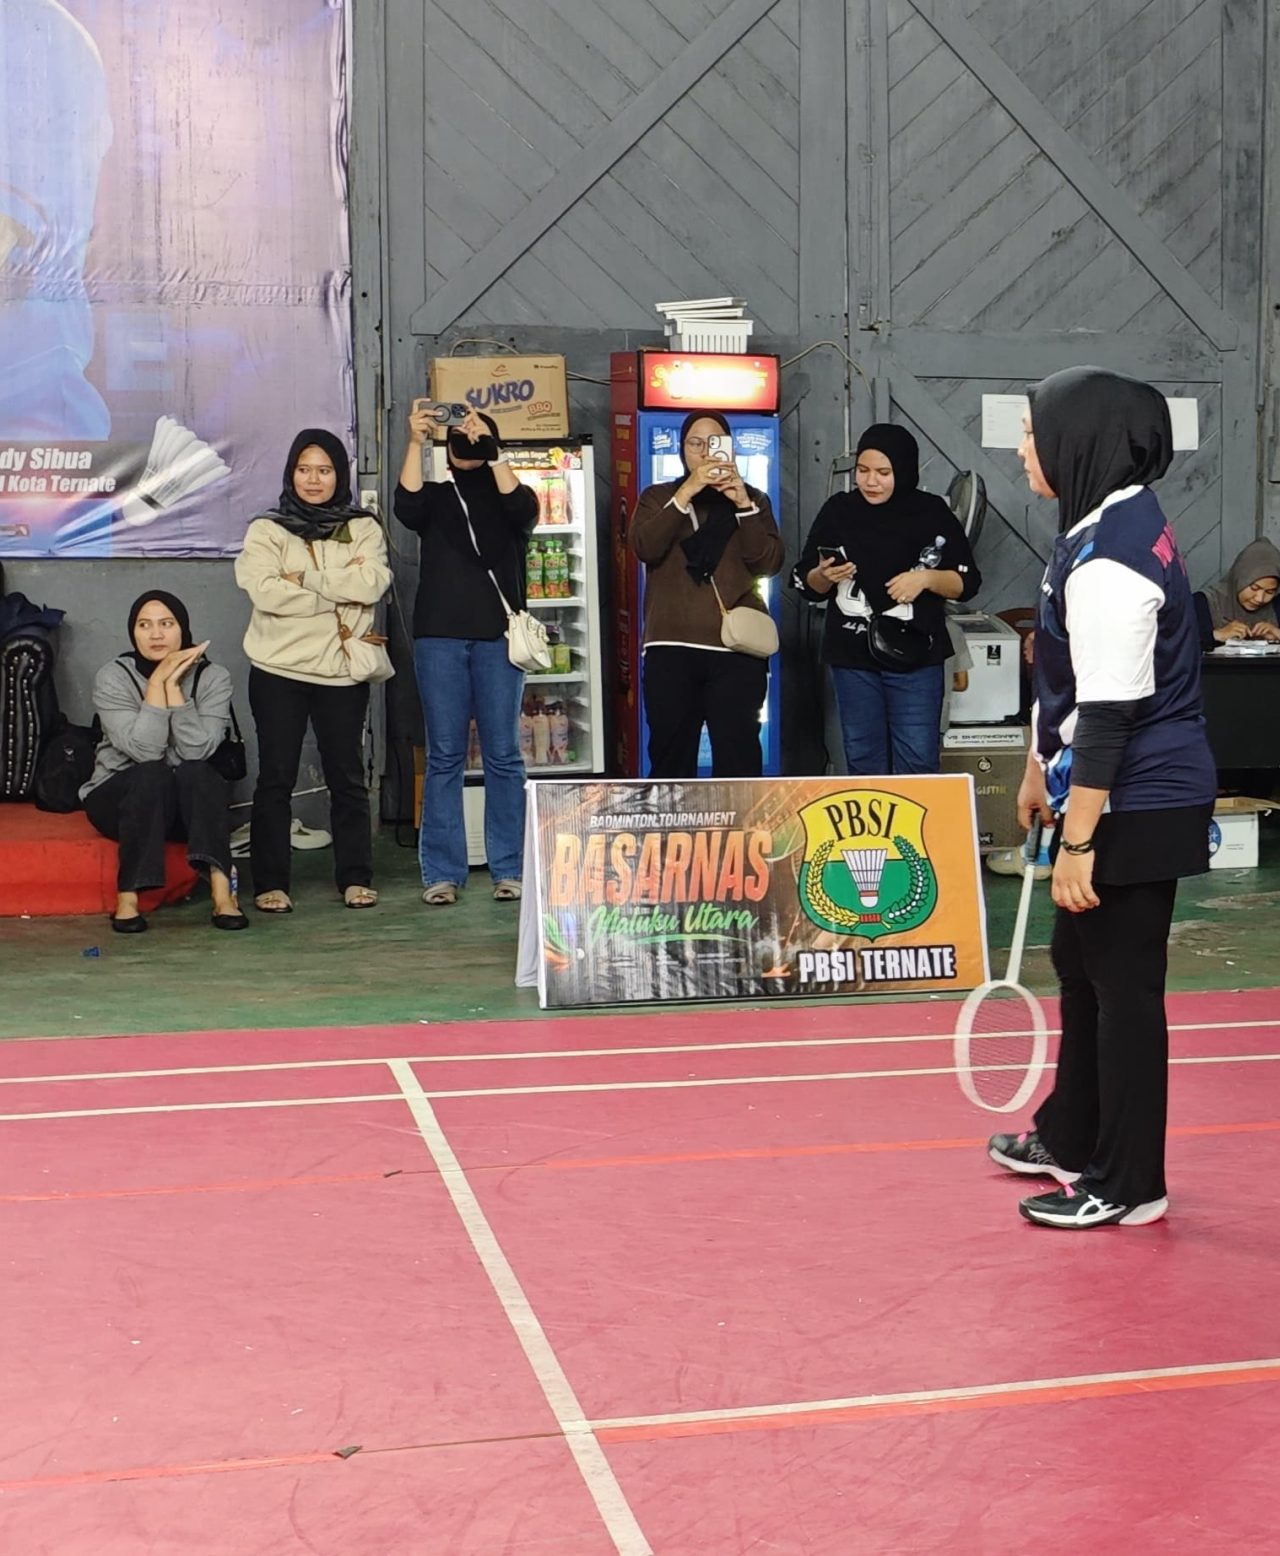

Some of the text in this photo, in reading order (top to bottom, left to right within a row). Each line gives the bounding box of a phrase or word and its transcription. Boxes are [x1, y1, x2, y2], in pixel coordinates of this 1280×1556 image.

[465, 379, 535, 410] SUKRO
[528, 401, 552, 415] BBQ
[29, 447, 93, 470] Sibua
[7, 475, 48, 492] Kota
[50, 475, 116, 492] Ternate
[590, 811, 737, 828] BADMINTON TOURNAMENT
[823, 798, 899, 842] PBSI
[551, 830, 773, 906] BASARNAS
[586, 902, 760, 944] Maluku Utara
[798, 946, 956, 983] PBSI TERNATE
